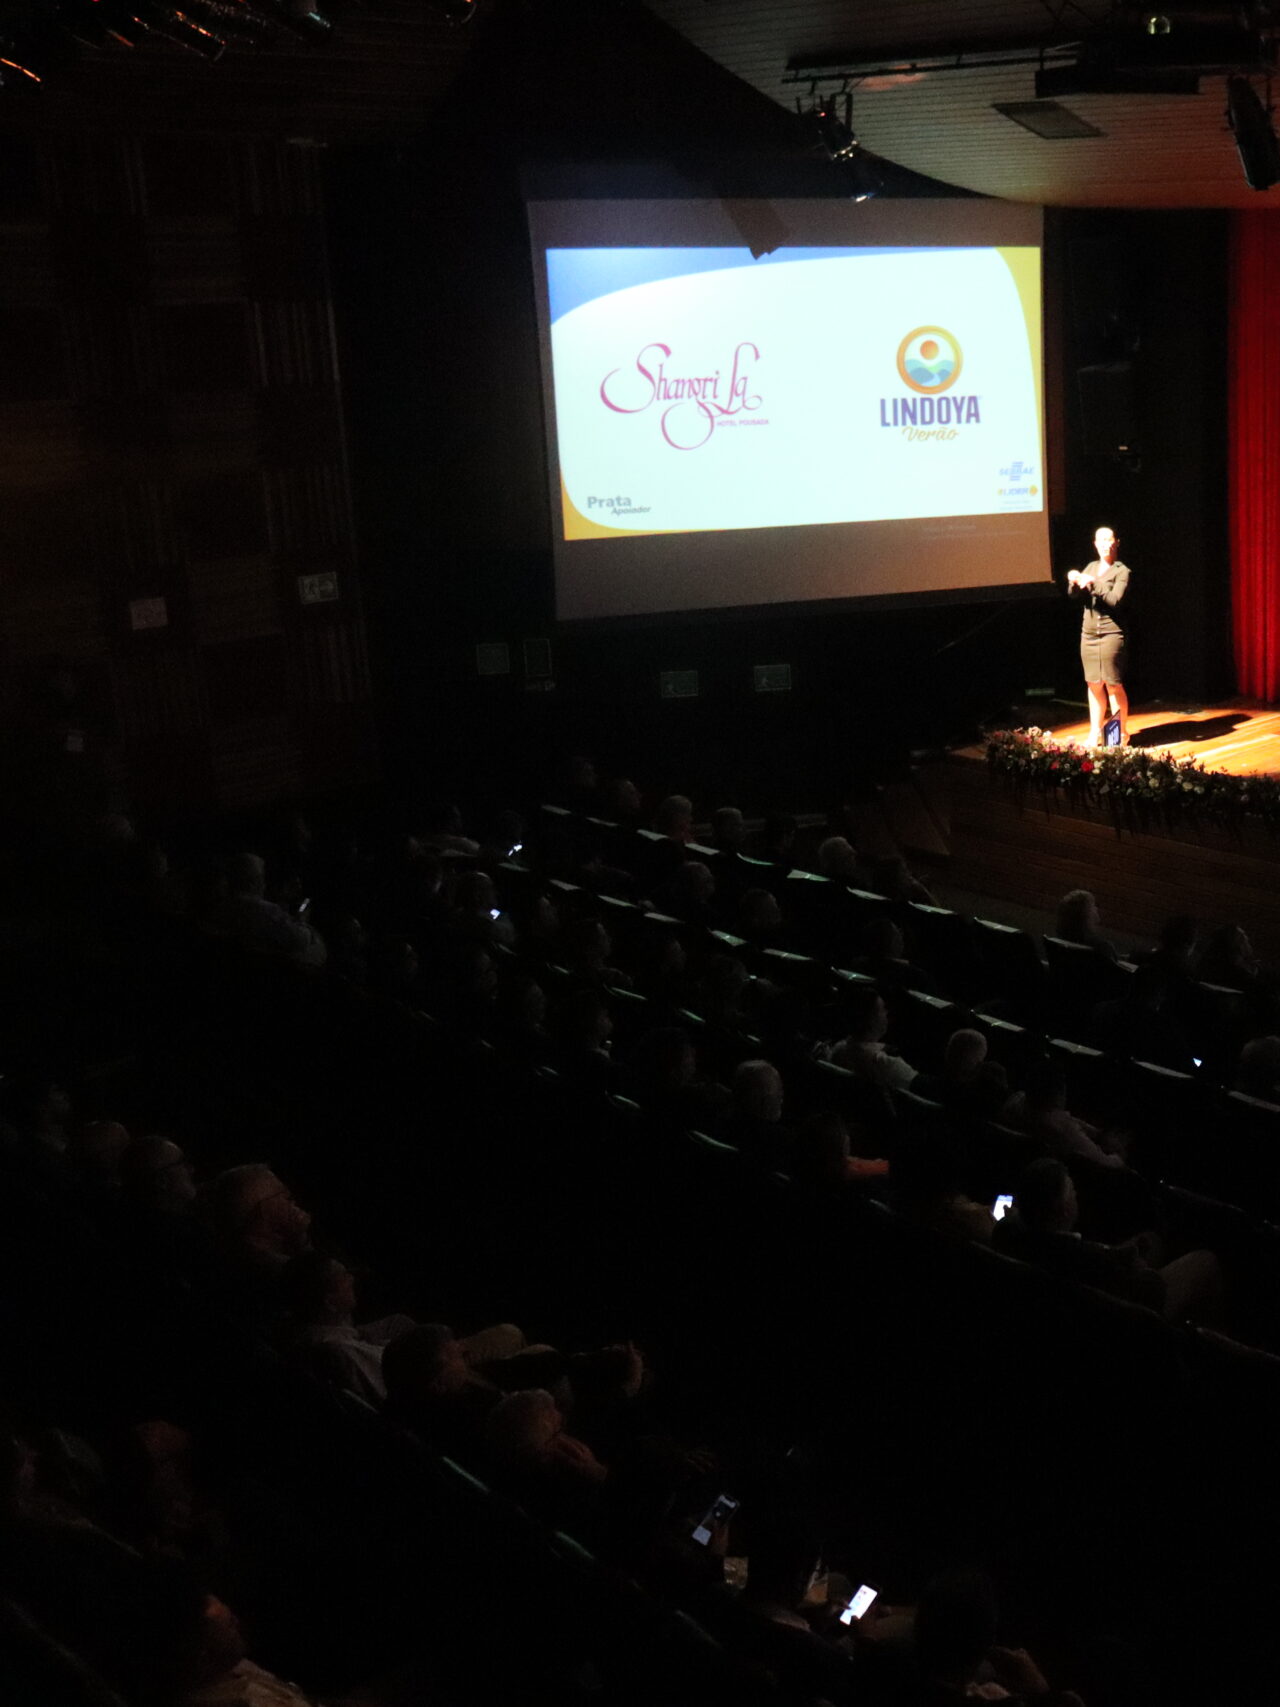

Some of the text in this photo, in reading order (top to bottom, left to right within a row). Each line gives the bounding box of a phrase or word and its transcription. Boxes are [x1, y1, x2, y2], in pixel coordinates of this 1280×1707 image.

[600, 343, 718, 450] Shangri
[880, 395, 980, 427] LINDOYA
[902, 425, 959, 442] Verão
[587, 496, 632, 509] Prata
